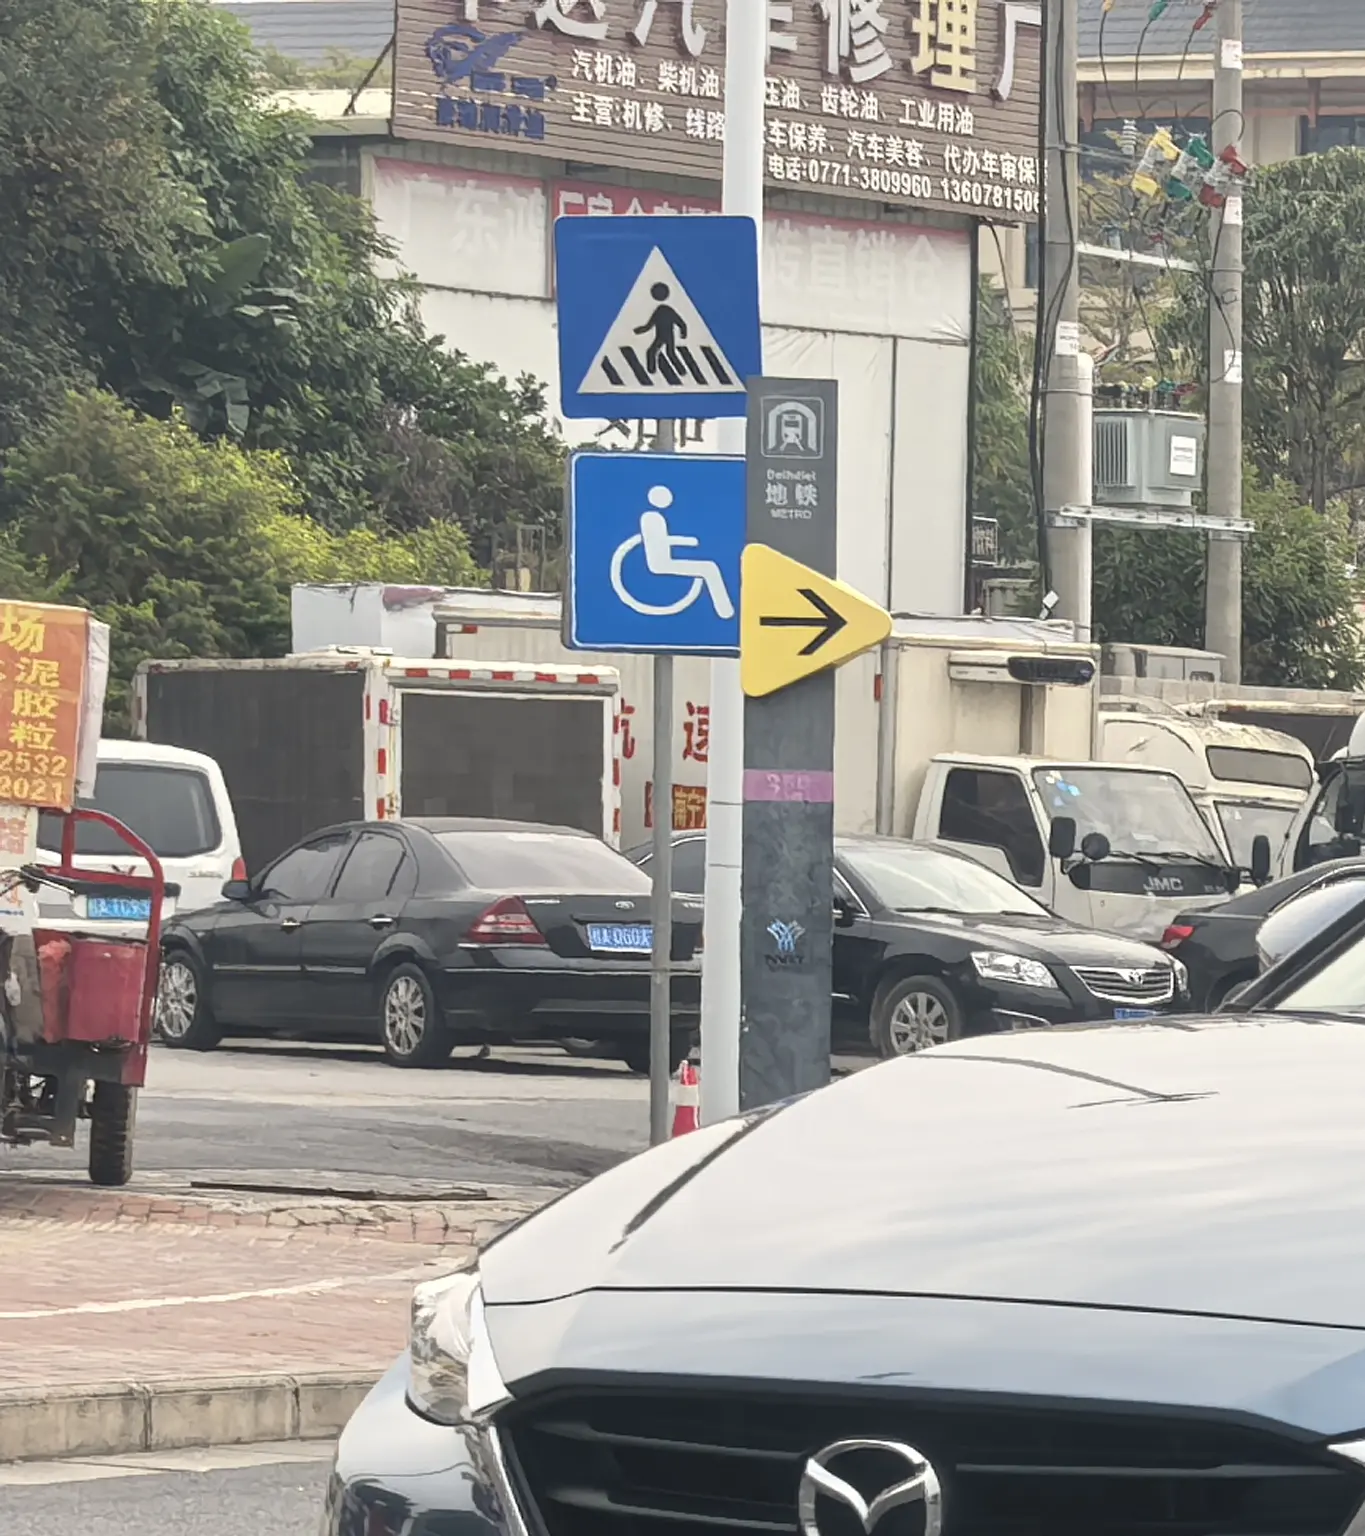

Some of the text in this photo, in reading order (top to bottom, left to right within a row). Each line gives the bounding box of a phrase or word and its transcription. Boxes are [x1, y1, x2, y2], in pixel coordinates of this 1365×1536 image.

[765, 481, 818, 506] 地铁
[770, 508, 812, 519] METRO
[1143, 876, 1184, 891] JMC
